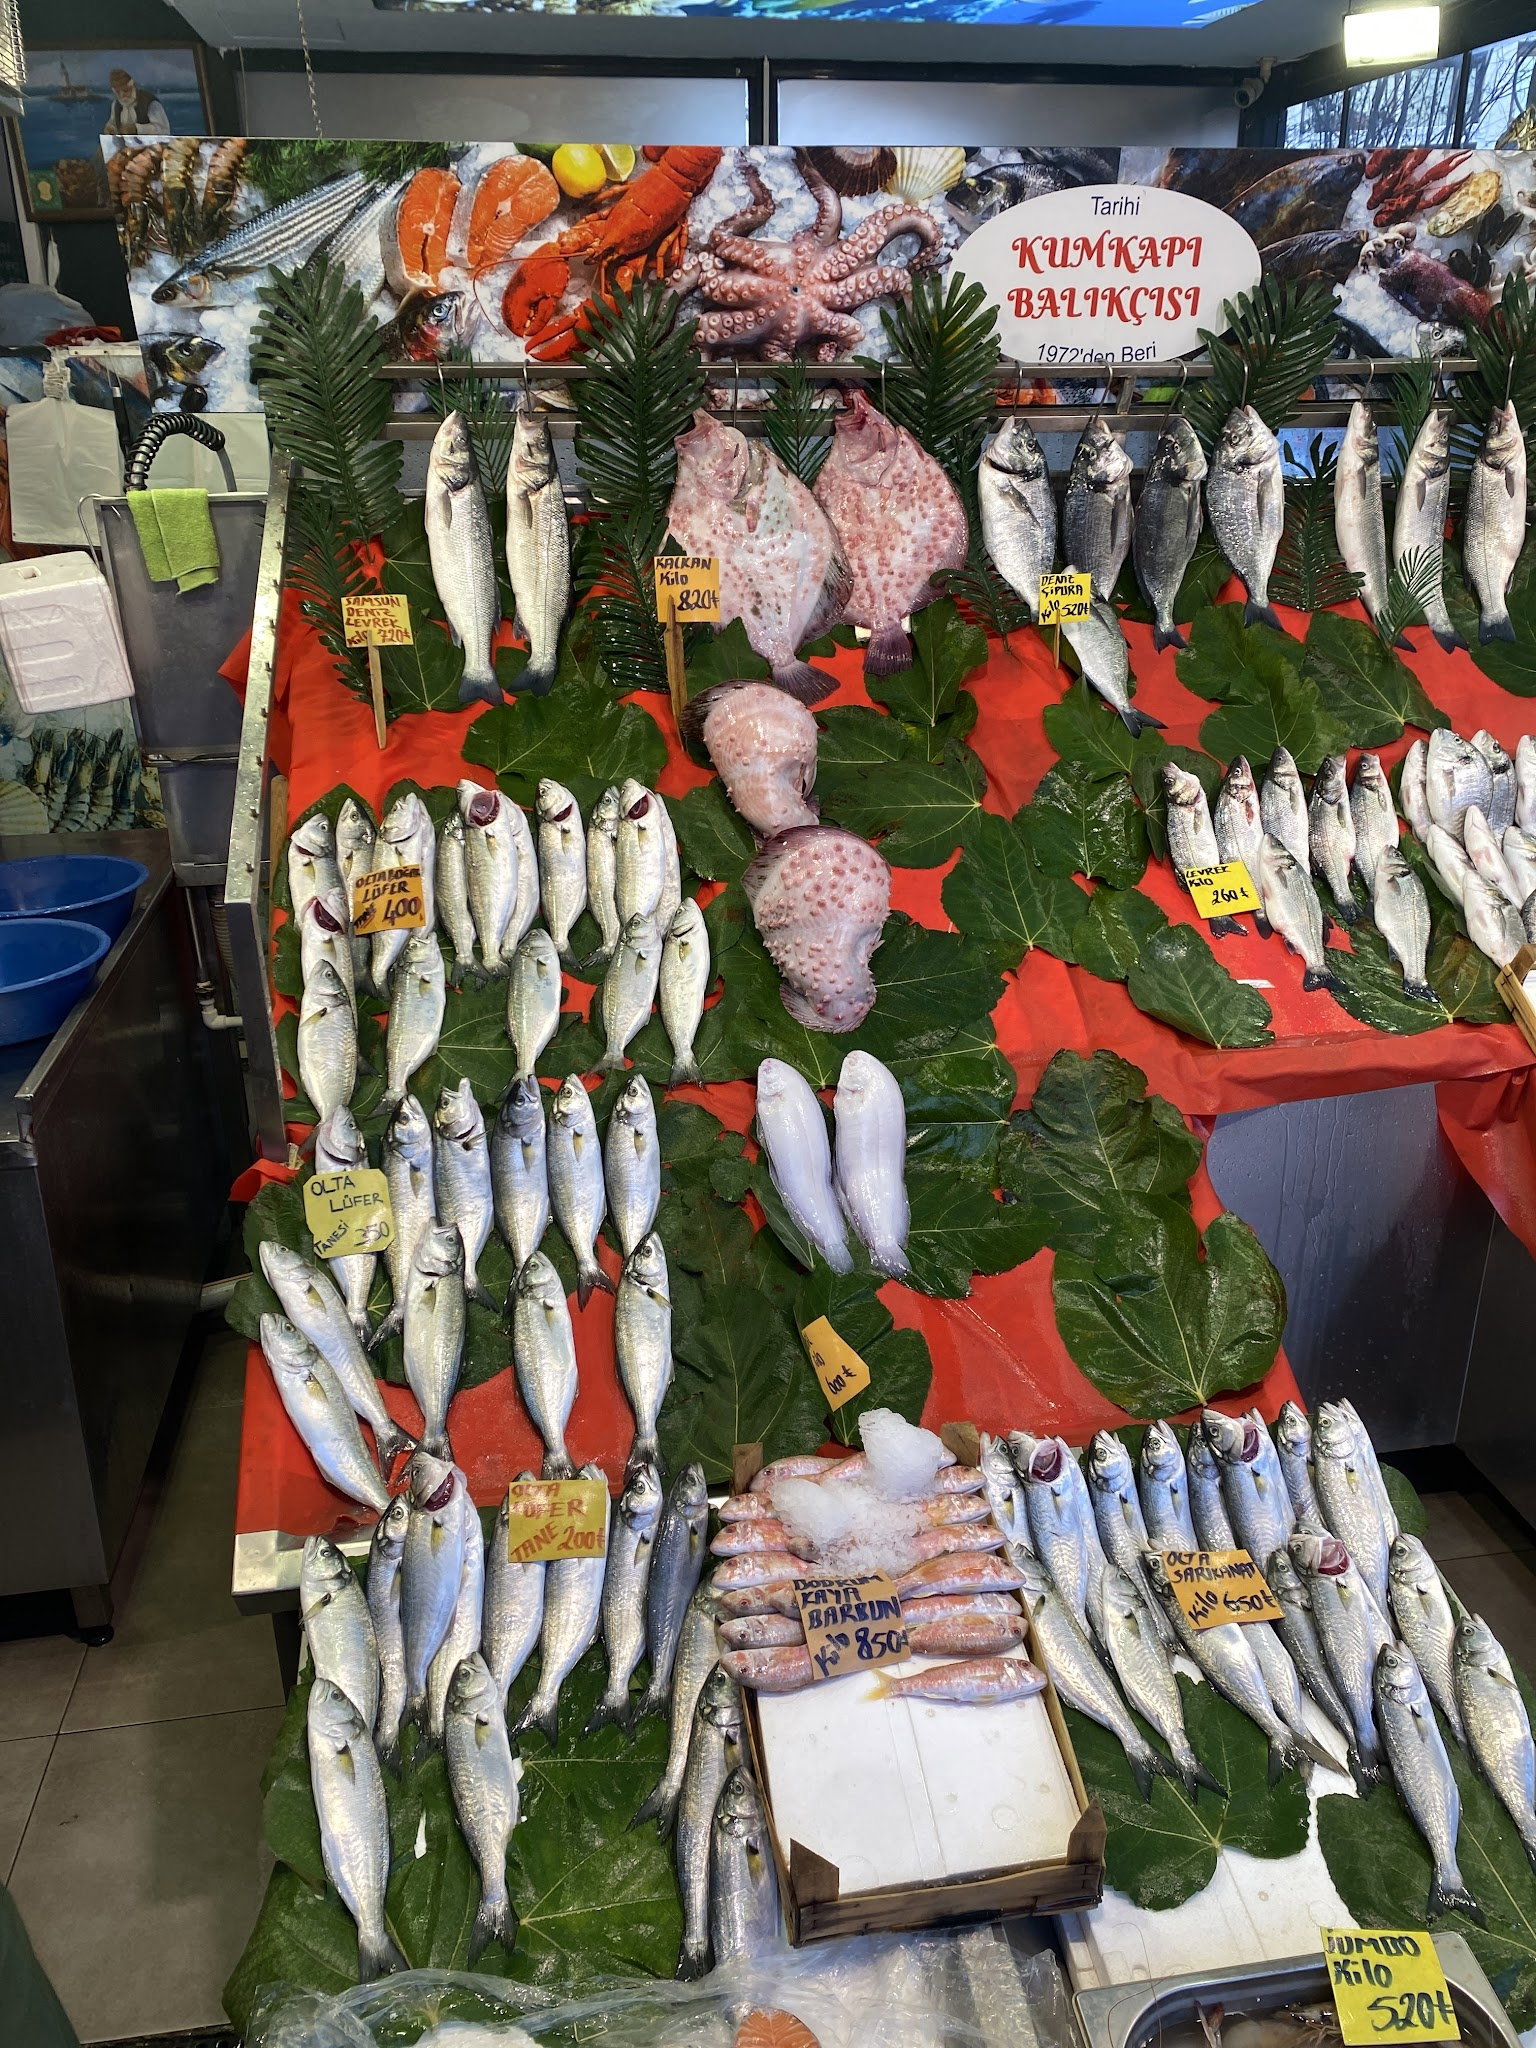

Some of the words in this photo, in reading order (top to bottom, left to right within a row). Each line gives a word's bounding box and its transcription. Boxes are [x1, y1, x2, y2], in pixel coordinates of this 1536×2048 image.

[1091, 196, 1140, 216] Tarihi
[1011, 230, 1202, 274] KUMKAPI
[1007, 286, 1201, 326] BALIKÇISI
[1038, 343, 1115, 363] 1972'den
[1122, 341, 1157, 363] Beri
[311, 1175, 356, 1196] OLTA
[329, 1192, 384, 1213] LÜFER
[510, 1521, 560, 1562] TANE
[801, 1587, 862, 1609] KAYA
[808, 1596, 901, 1631] BARBUN
